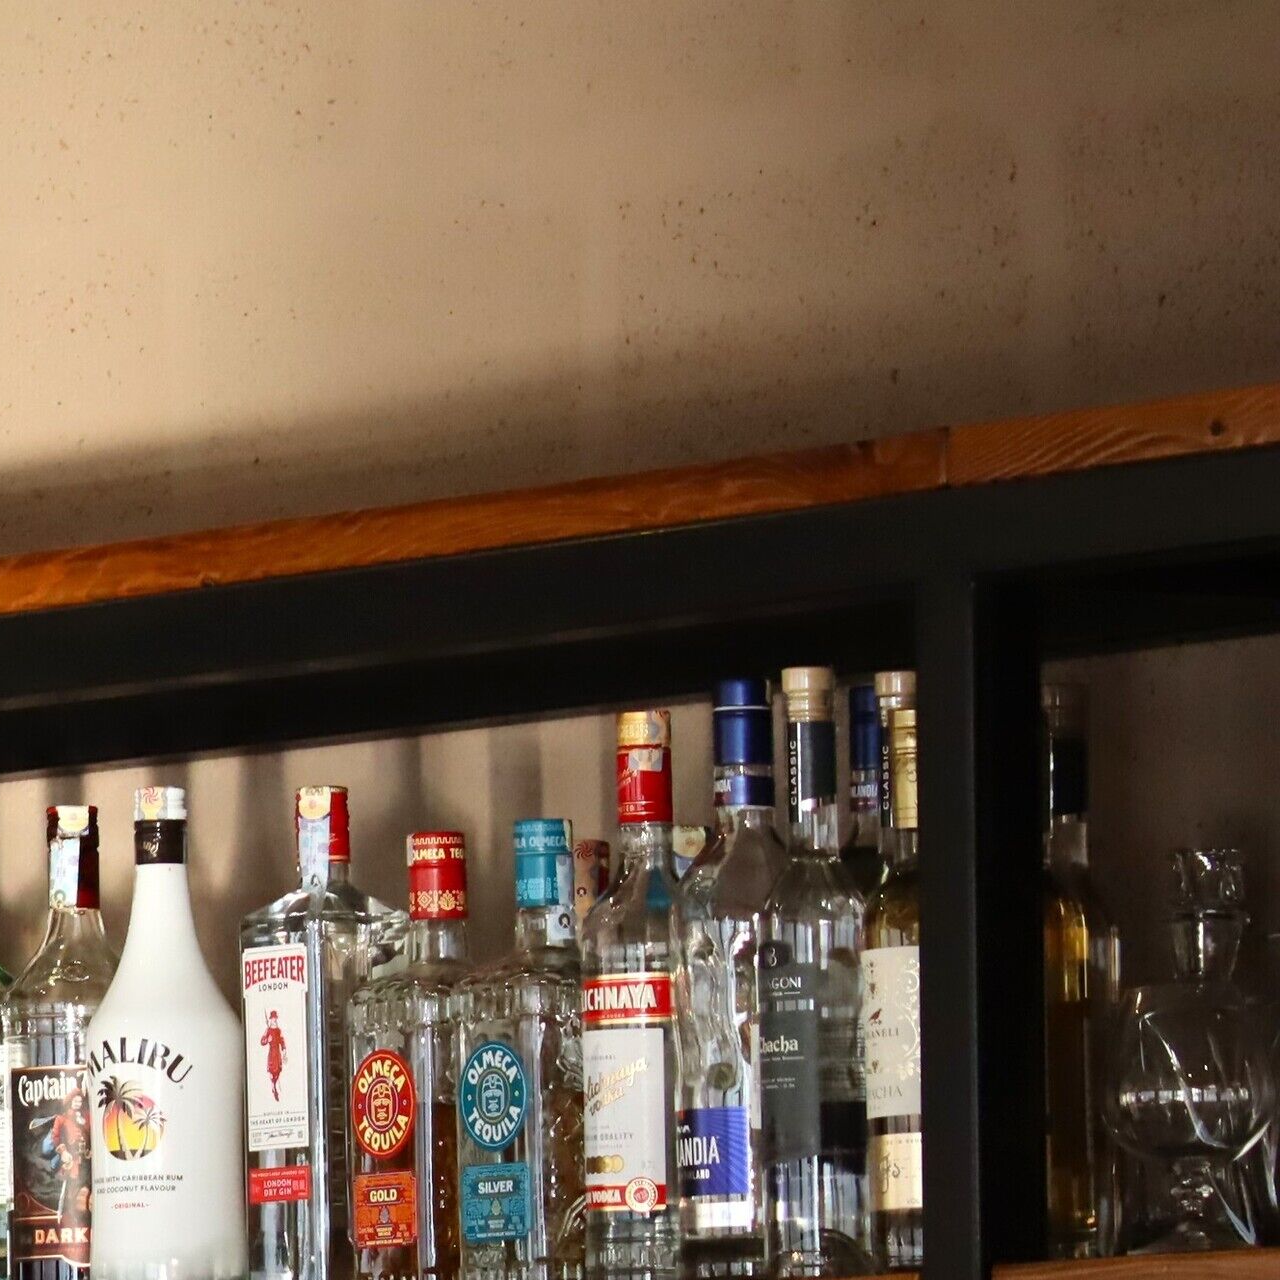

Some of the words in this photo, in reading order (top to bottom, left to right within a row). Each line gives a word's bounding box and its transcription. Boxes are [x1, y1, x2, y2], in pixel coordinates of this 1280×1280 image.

[244, 955, 305, 991] BEEFEATER
[258, 982, 289, 992] LONDON
[89, 1036, 193, 1086] MALIBU
[467, 1050, 519, 1085] OLMECA
[357, 1059, 406, 1094] OLMECA
[358, 1114, 409, 1151] TEQUILA
[468, 1105, 522, 1143] TEQUILA
[107, 1185, 138, 1193] COCONUT
[140, 1184, 176, 1192] FLAVOUR
[263, 1179, 292, 1188] LONDON
[263, 1188, 277, 1197] DRY
[279, 1187, 292, 1196] GIN
[477, 1180, 514, 1194] SILVER
[369, 1188, 397, 1202] GOLD
[35, 1227, 88, 1244] DARK
